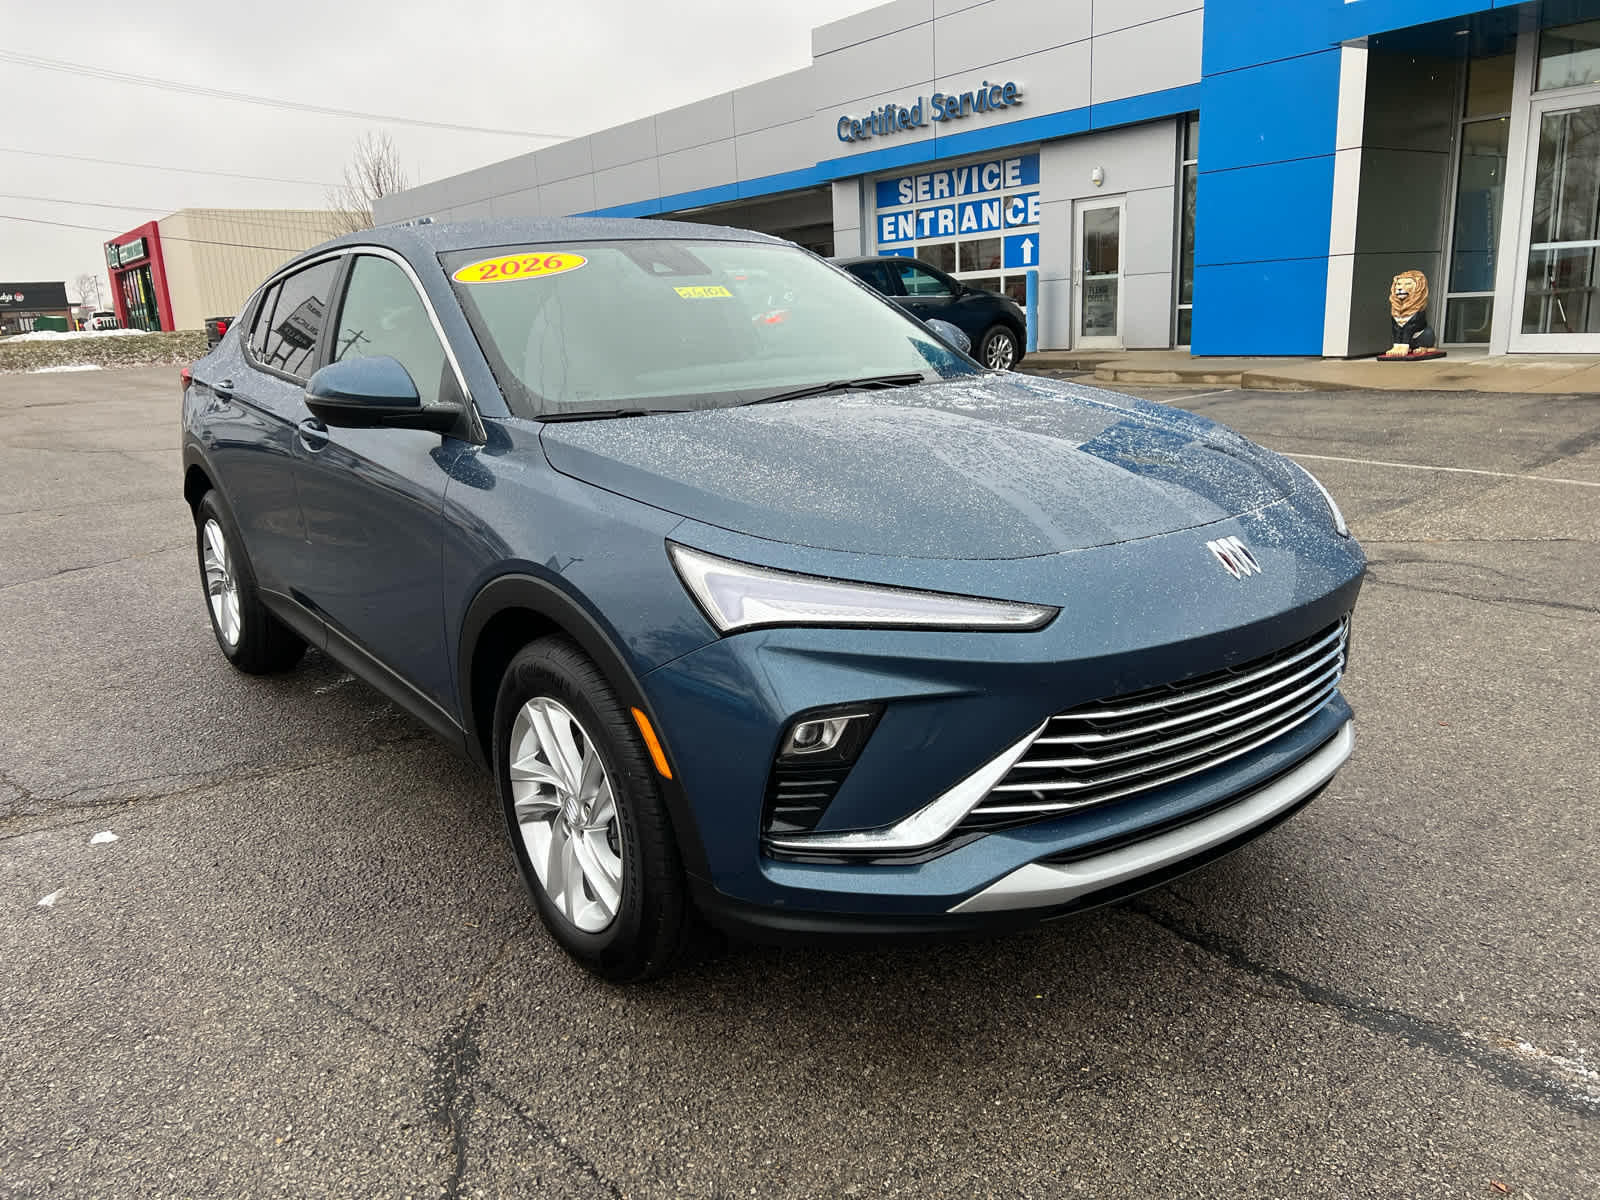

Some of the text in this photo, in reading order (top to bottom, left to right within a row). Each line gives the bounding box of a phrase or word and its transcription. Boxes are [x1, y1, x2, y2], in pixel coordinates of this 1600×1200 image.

[837, 81, 1017, 142] Certified Service
[898, 159, 1021, 204] SERVICE
[882, 196, 1040, 241] ENTRANCE
[479, 255, 563, 281] 2026
